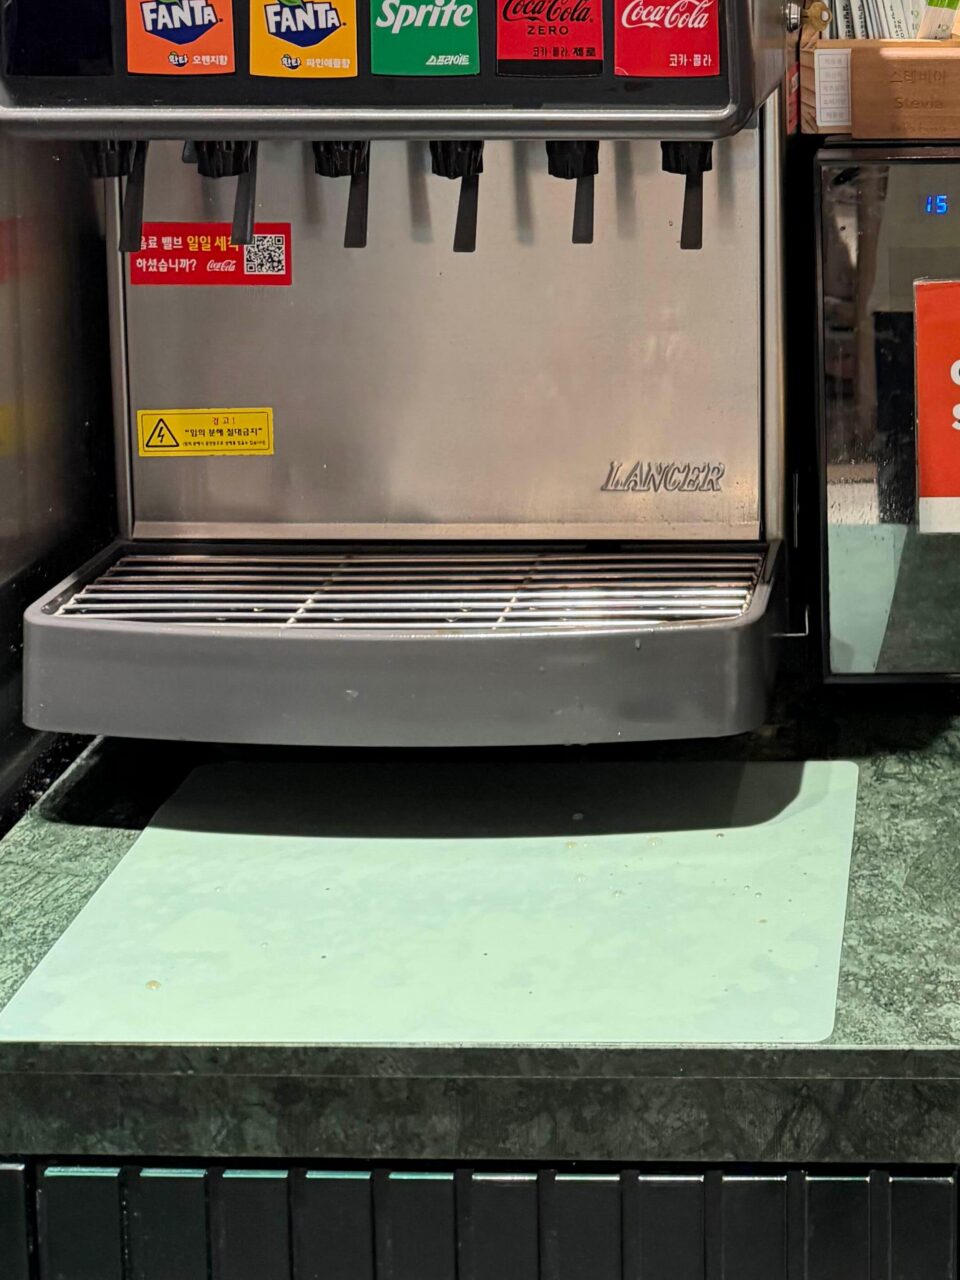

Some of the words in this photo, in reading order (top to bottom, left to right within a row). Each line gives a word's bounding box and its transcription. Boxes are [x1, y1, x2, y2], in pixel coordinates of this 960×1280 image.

[141, 0, 216, 31] FANTA
[264, 2, 340, 33] FANTA
[527, 25, 569, 35] ZERO
[192, 54, 228, 66] 오렌지향
[425, 54, 470, 66] 스프라이트
[895, 97, 944, 109] Stevia
[925, 195, 948, 214] 15
[186, 235, 212, 251] 일일
[136, 258, 197, 272] 하셨습니까?
[600, 460, 725, 492] LANCER
